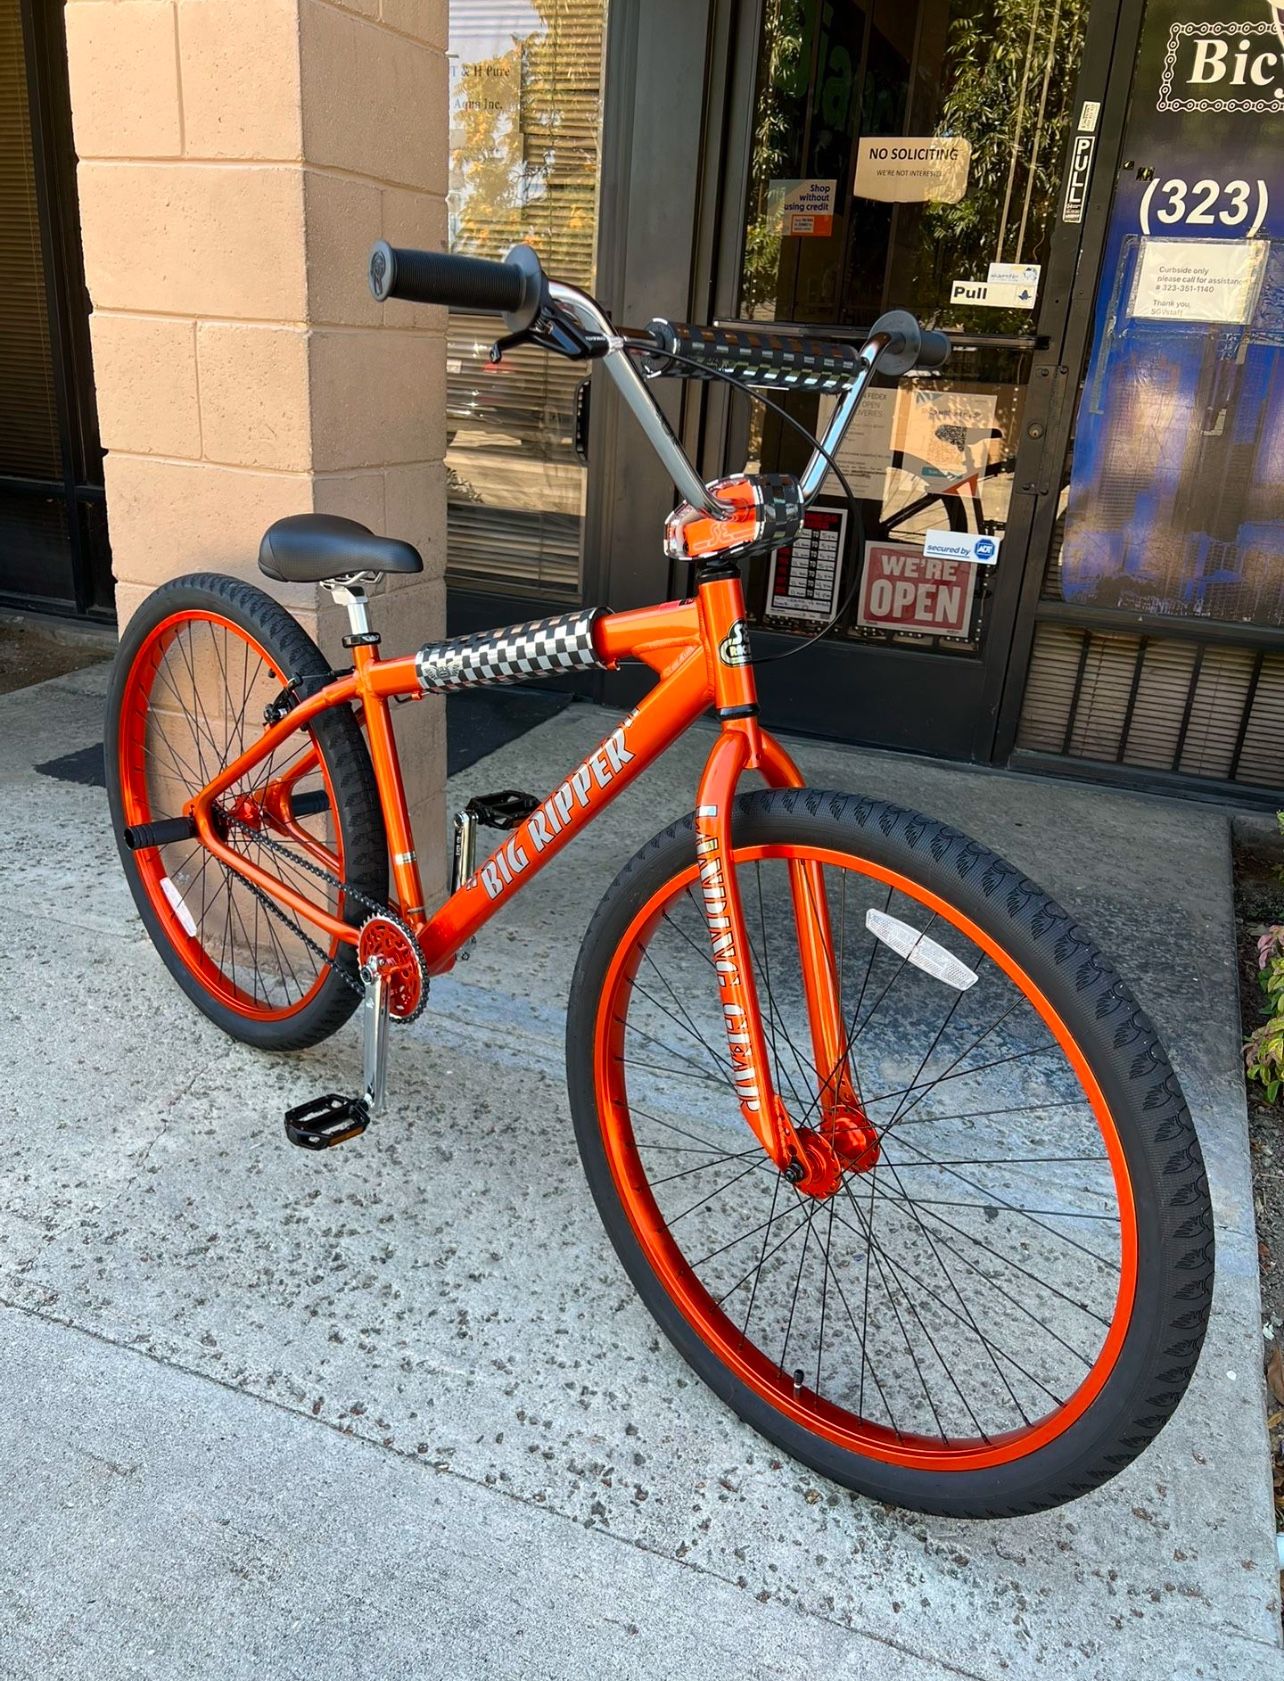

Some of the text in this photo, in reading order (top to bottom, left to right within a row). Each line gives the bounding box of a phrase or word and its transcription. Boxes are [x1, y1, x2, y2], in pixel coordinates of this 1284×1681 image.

[474, 66, 483, 77] H
[869, 147, 959, 161] NO SOLICITING
[1069, 139, 1091, 203] PULL
[810, 184, 831, 193] Shop
[799, 193, 829, 202] without
[784, 203, 829, 212] using credit
[1139, 177, 1269, 238] (323)
[1159, 266, 1209, 275] Curbside only
[1157, 275, 1181, 284] please
[1182, 275, 1196, 284] call
[1196, 276, 1207, 284] for
[953, 286, 988, 300] Pull
[1153, 299, 1175, 307] Thank
[927, 544, 972, 556] secured by
[881, 555, 959, 582] WE'RE
[869, 578, 962, 624] OPEN
